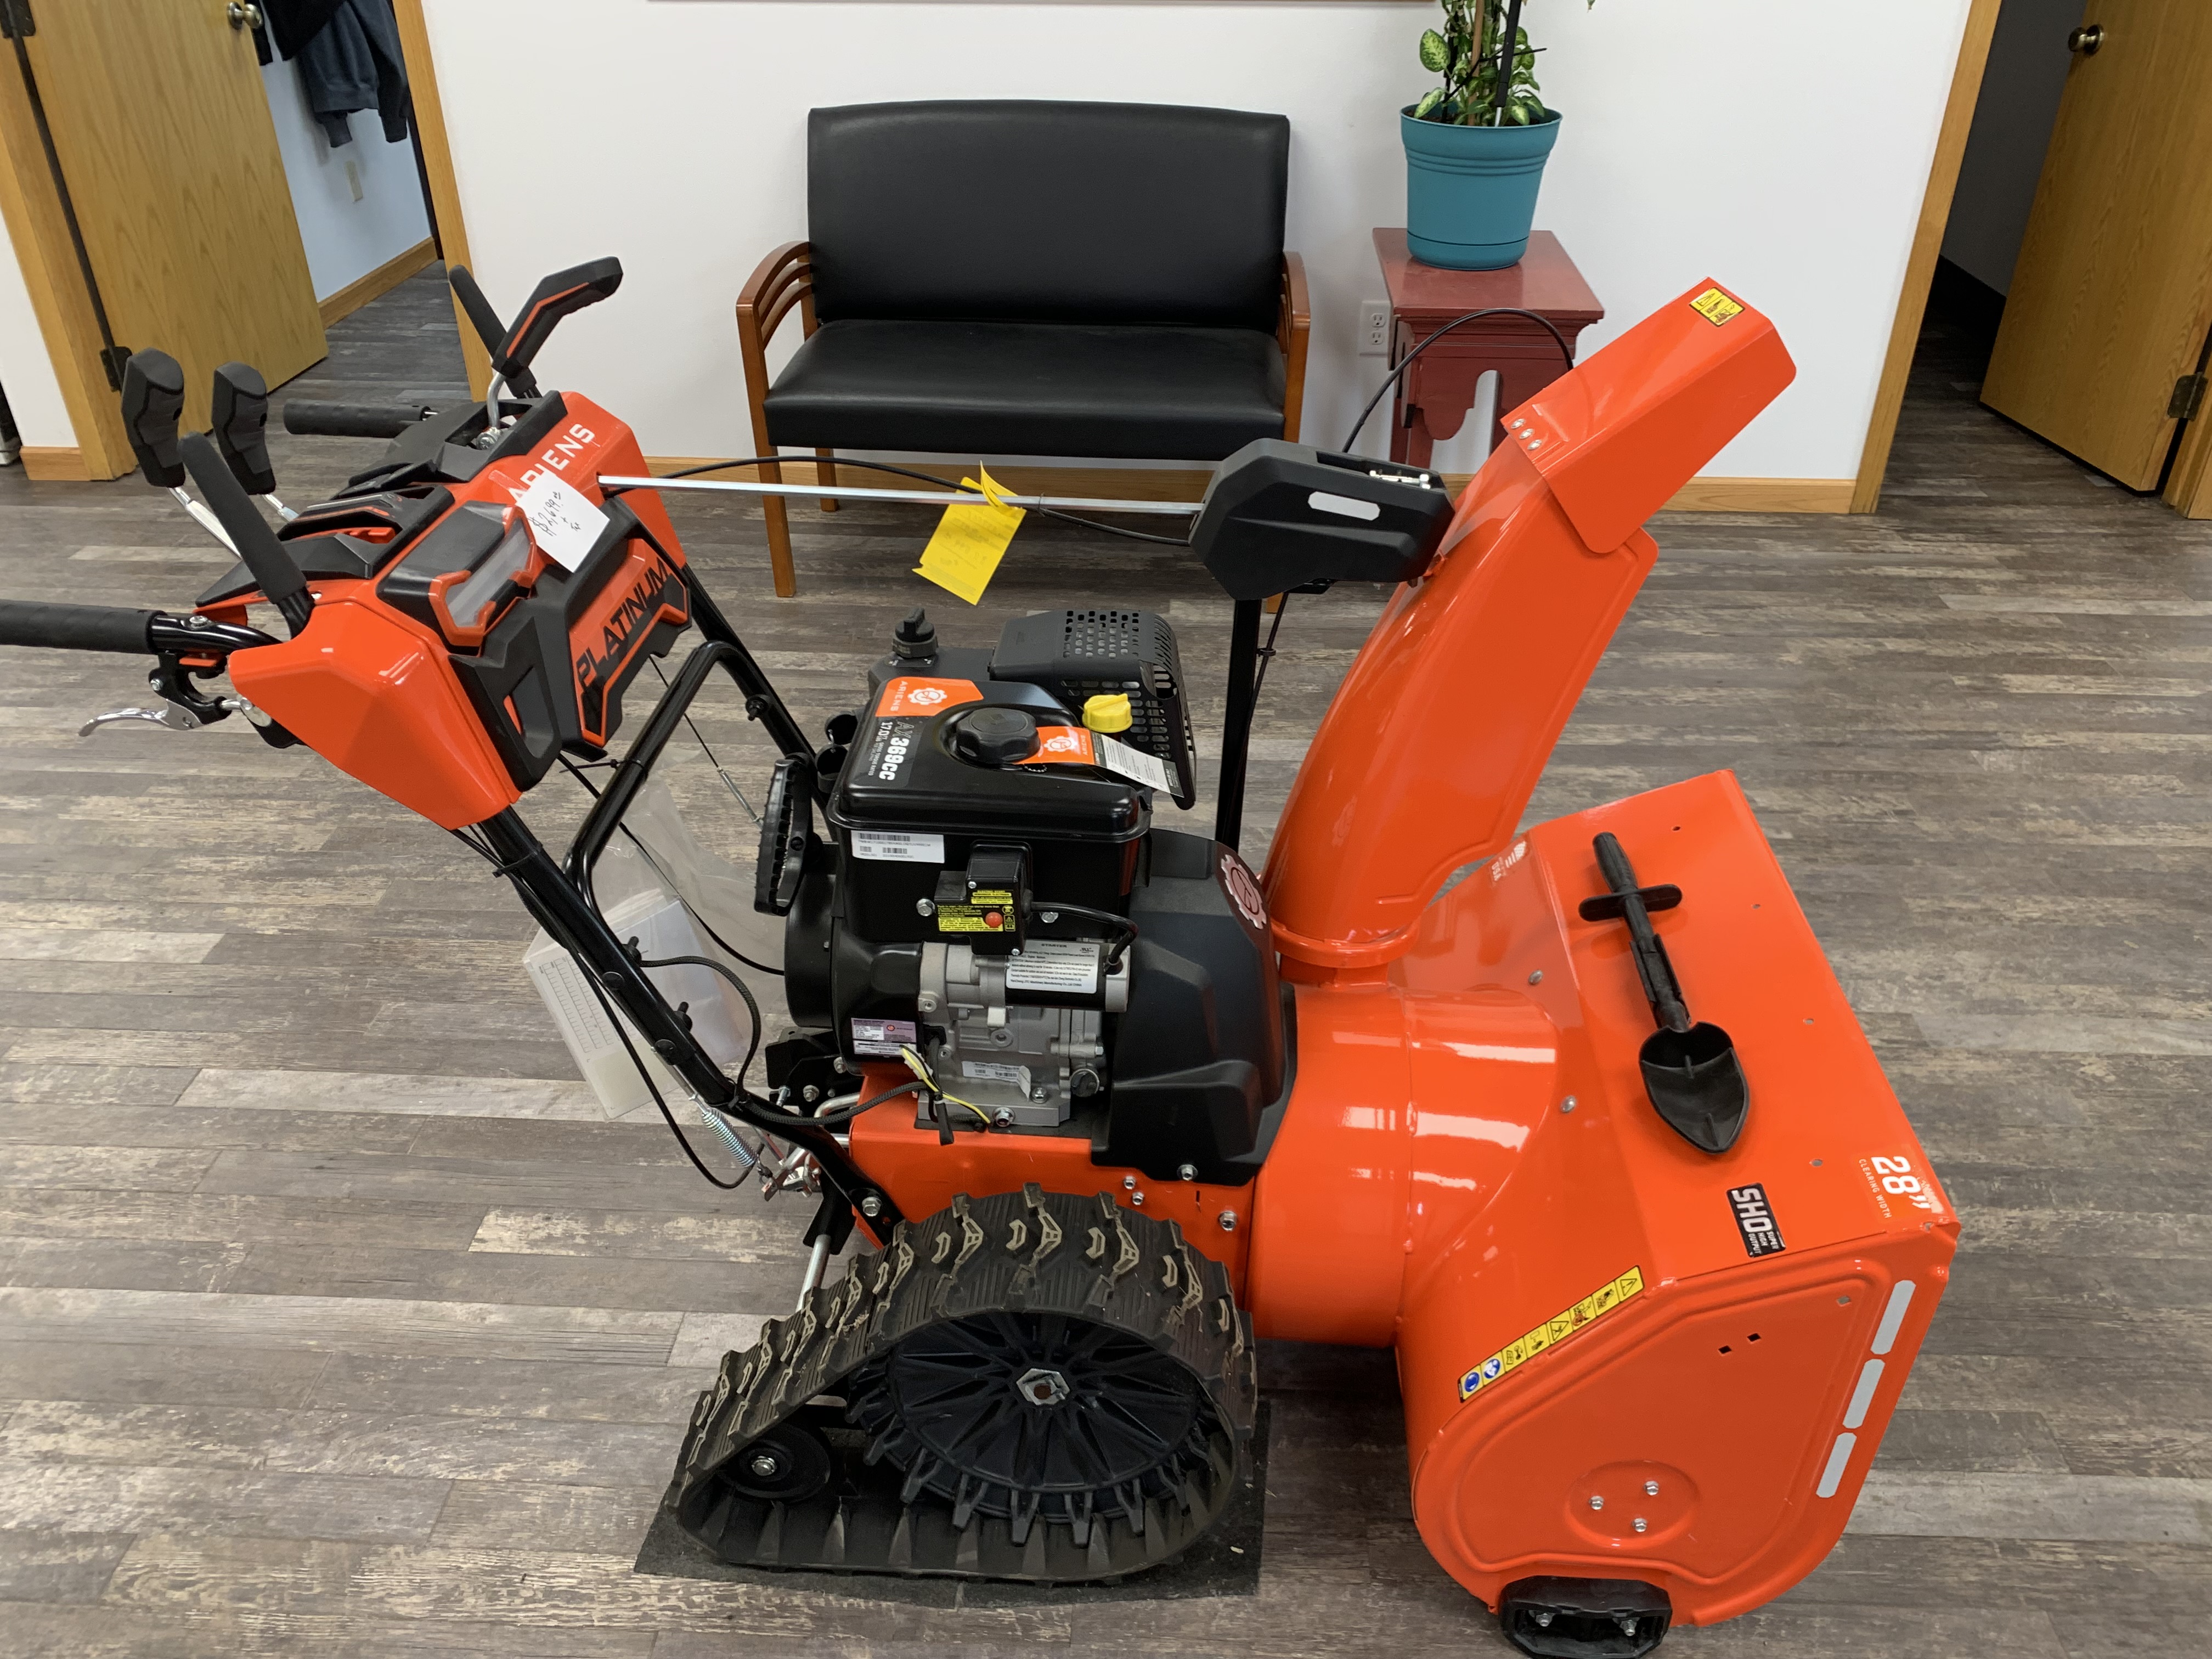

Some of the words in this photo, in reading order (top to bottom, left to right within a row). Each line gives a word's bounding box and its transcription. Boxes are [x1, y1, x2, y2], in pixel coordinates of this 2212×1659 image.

[576, 557, 669, 687] PLATINUM
[890, 680, 909, 712] ARIENS
[1858, 1159, 1880, 1194] CLEARING
[1876, 1194, 1893, 1219] WIDTH
[1731, 1188, 1772, 1233] SHO
[1748, 1233, 1761, 1255] OUTPUT
[1757, 1232, 1767, 1248] HIGH
[1766, 1231, 1779, 1250] SUPER
